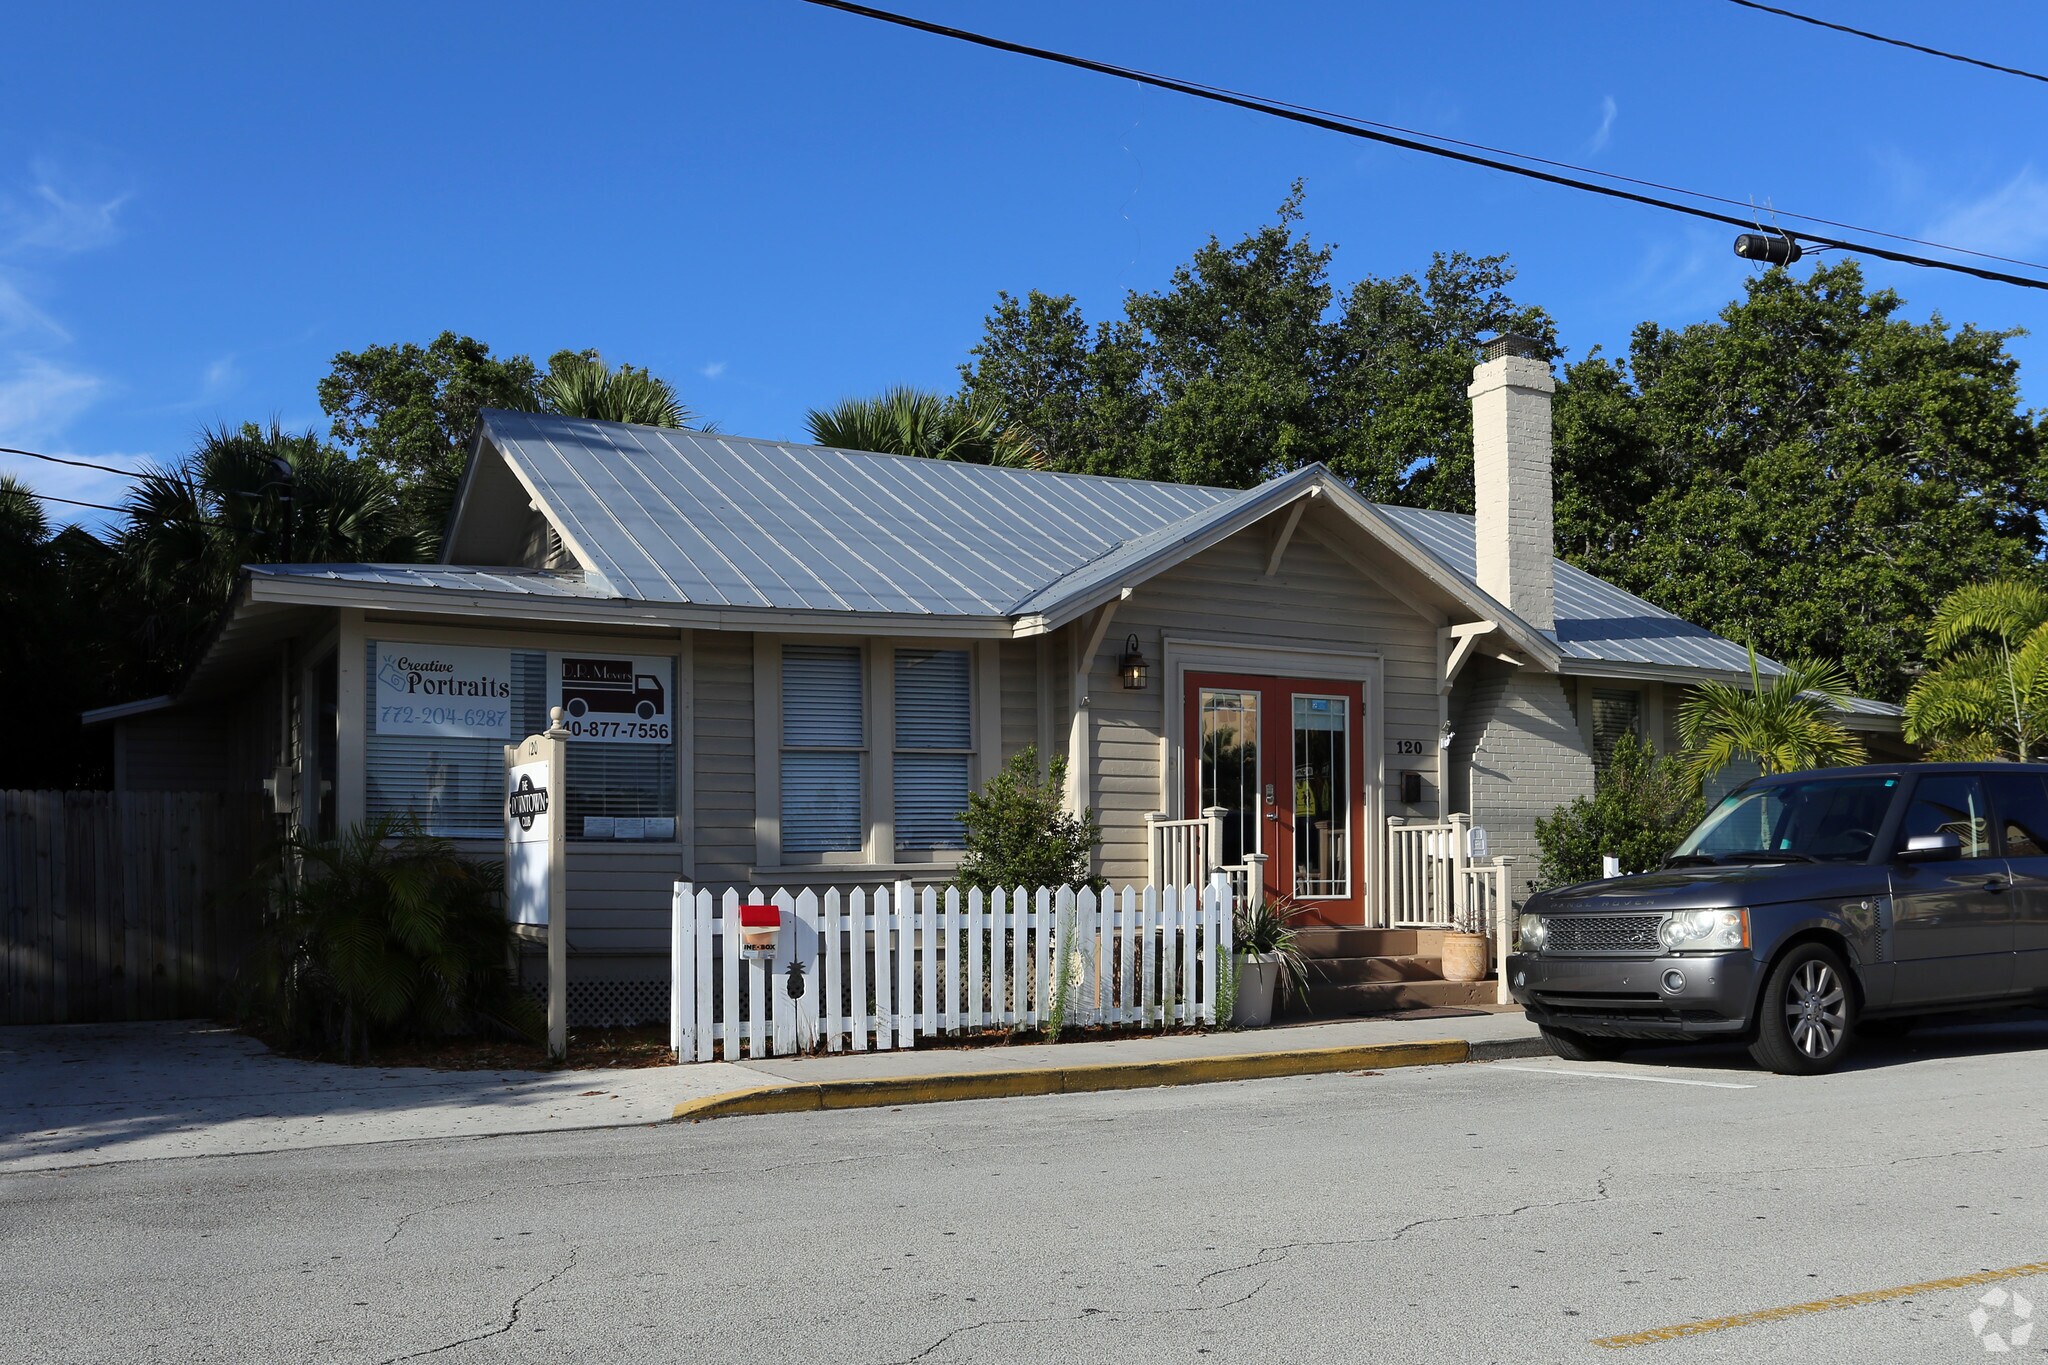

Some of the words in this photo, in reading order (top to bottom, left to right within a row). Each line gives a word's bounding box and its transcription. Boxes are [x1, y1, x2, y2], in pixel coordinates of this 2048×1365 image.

[398, 657, 453, 672] Creative
[562, 663, 590, 678] D.R.
[593, 665, 632, 680] Movers
[406, 671, 510, 698] Portraits
[381, 706, 507, 727] 772-204-6287
[551, 721, 669, 739] 40-877-7556
[528, 740, 538, 757] 120
[1397, 741, 1422, 754] 120
